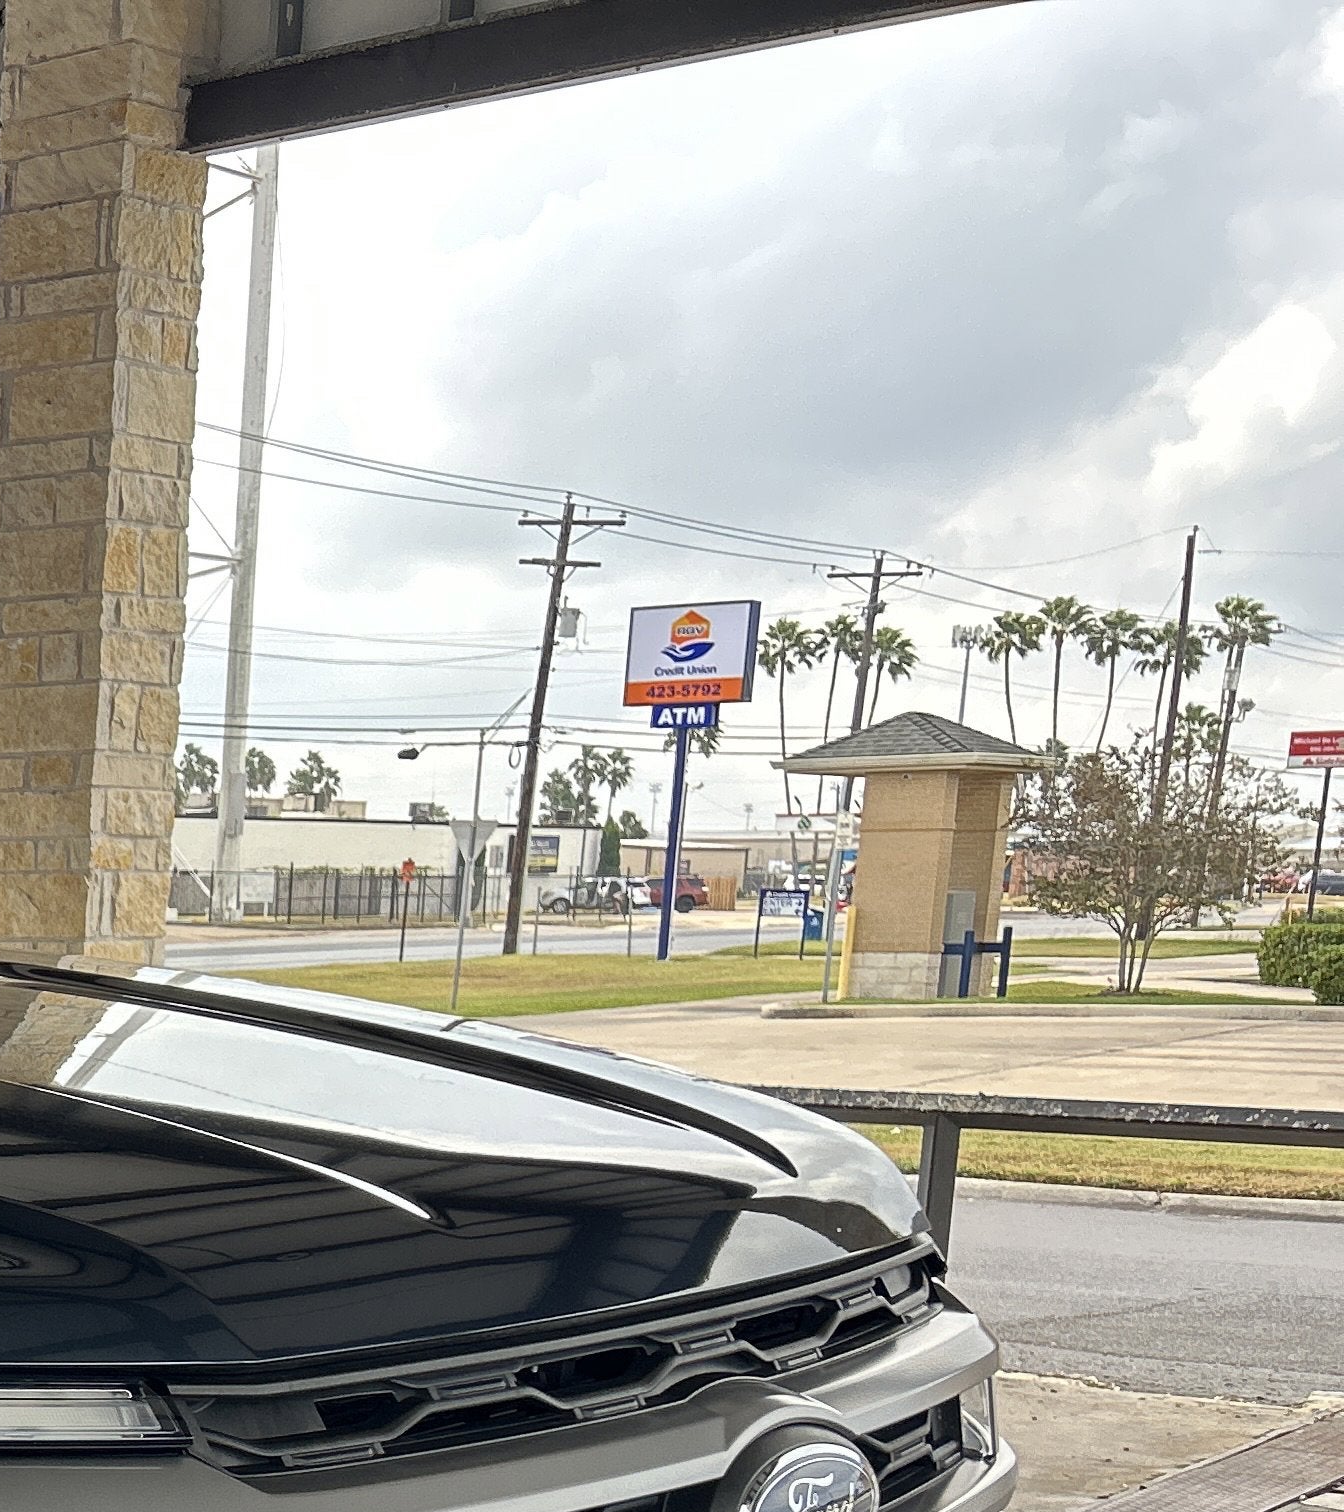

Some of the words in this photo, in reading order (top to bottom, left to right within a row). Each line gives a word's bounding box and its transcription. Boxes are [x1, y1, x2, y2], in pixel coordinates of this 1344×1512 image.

[654, 665, 685, 677] Credit
[687, 664, 718, 676] Union
[646, 682, 722, 699] 423-5792
[657, 706, 706, 726] ATM
